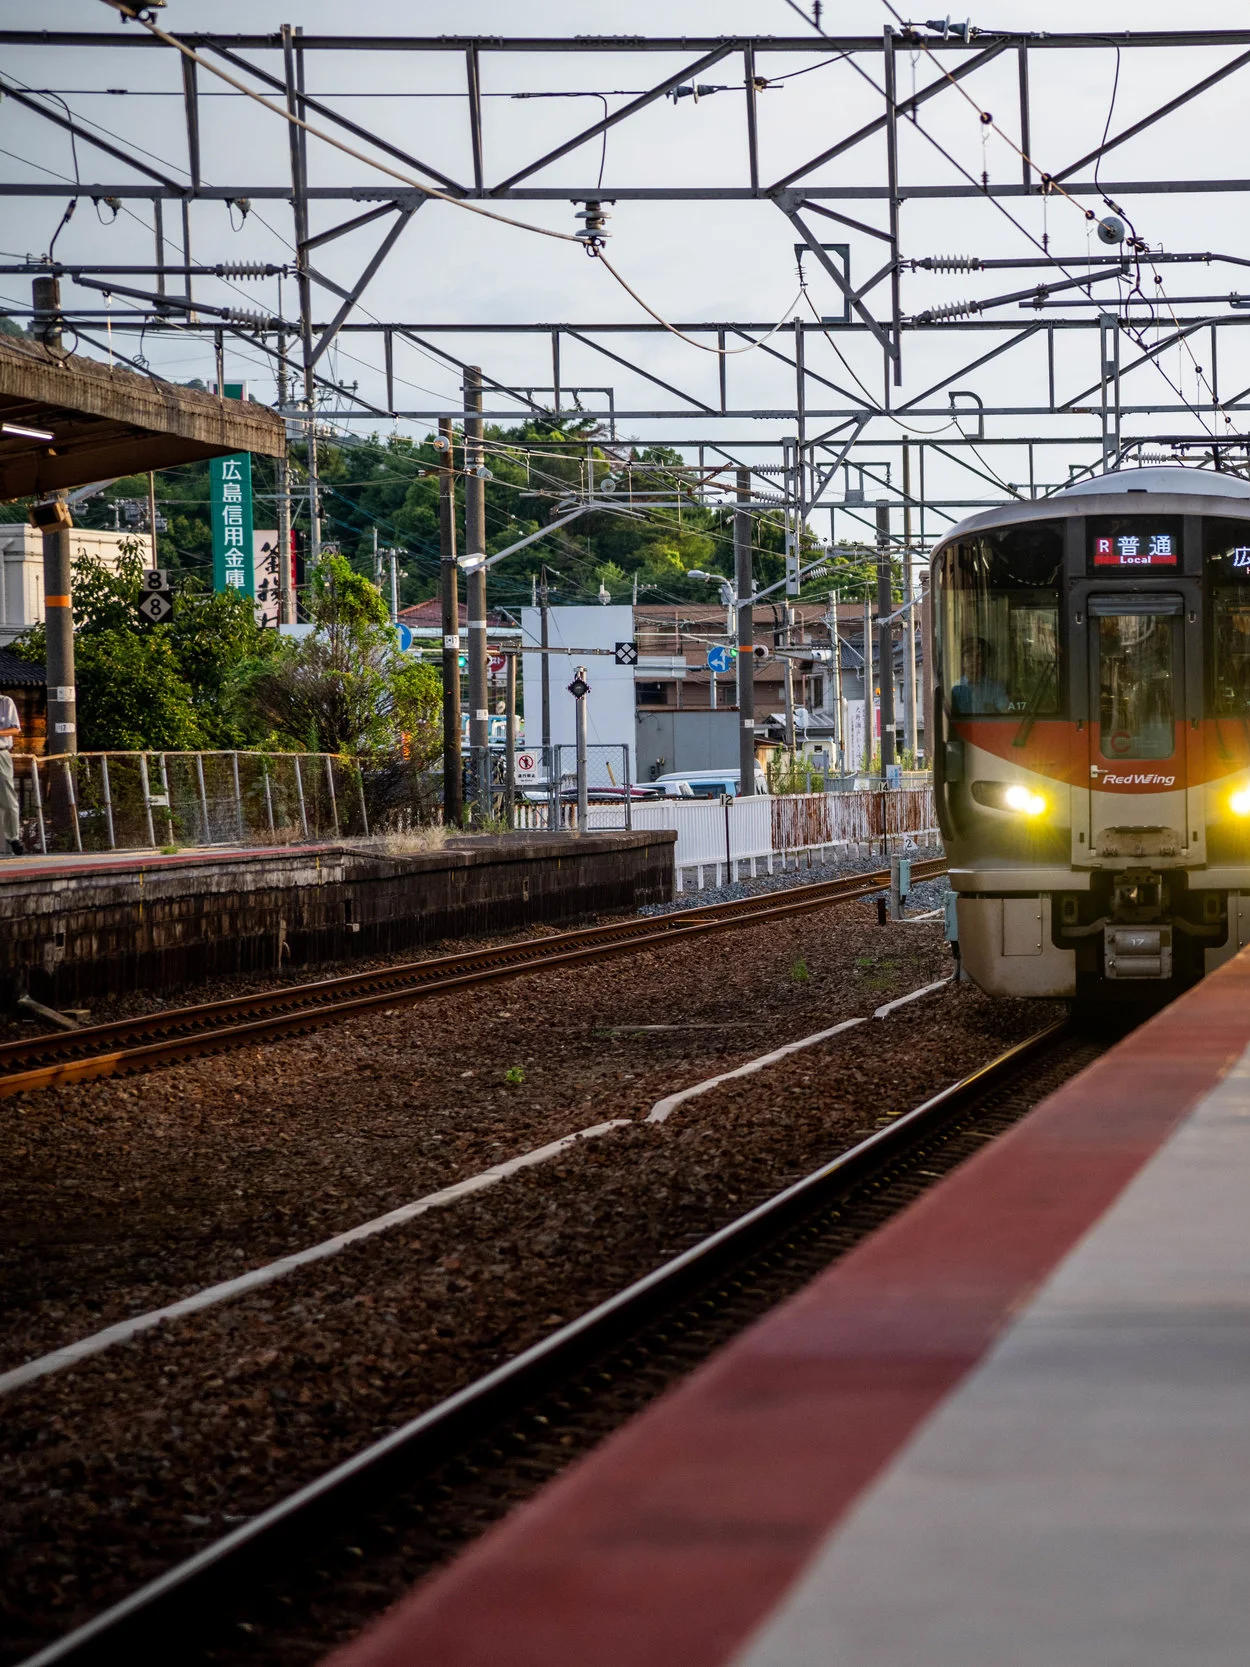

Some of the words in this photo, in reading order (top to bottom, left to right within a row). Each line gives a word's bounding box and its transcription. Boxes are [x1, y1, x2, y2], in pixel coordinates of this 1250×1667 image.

[222, 459, 245, 589] 広島信用金庫
[1099, 539, 1110, 553] R
[1117, 535, 1172, 556] 普通
[1120, 555, 1151, 564] Local
[148, 571, 162, 590] 8
[150, 598, 162, 616] 8
[1007, 701, 1027, 711] A17
[879, 782, 889, 792] 14
[721, 794, 734, 806] 12
[905, 838, 913, 848] 2
[1131, 938, 1145, 946] 17
